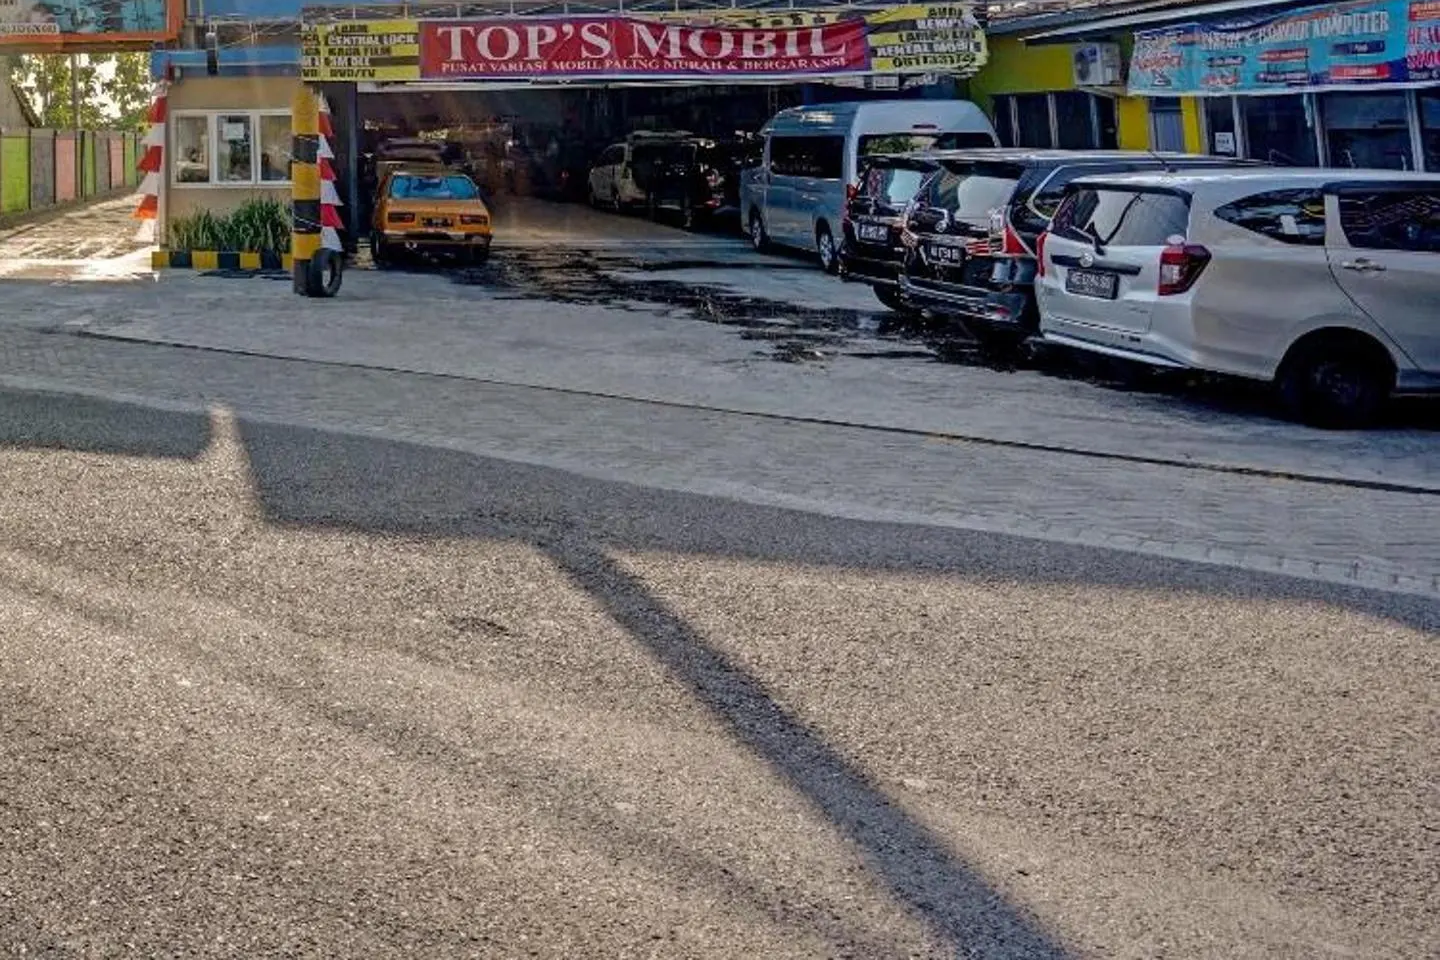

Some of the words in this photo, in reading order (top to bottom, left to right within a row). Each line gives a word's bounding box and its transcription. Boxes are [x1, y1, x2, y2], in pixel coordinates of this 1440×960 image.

[1313, 11, 1389, 38] KOMPUTER
[328, 34, 379, 45] CENTRAL
[383, 34, 415, 44] LOCK
[629, 22, 847, 59] MOBIL
[876, 43, 928, 56] RENTAL
[441, 61, 486, 73] PUSAT
[489, 60, 548, 73] VARIASI
[551, 60, 601, 71] MOBIL
[602, 59, 659, 71] PALING
[663, 59, 722, 71] MURAH
[726, 59, 738, 70] &
[743, 57, 847, 70] BERGARANSI
[329, 68, 376, 78] DVD/TV
